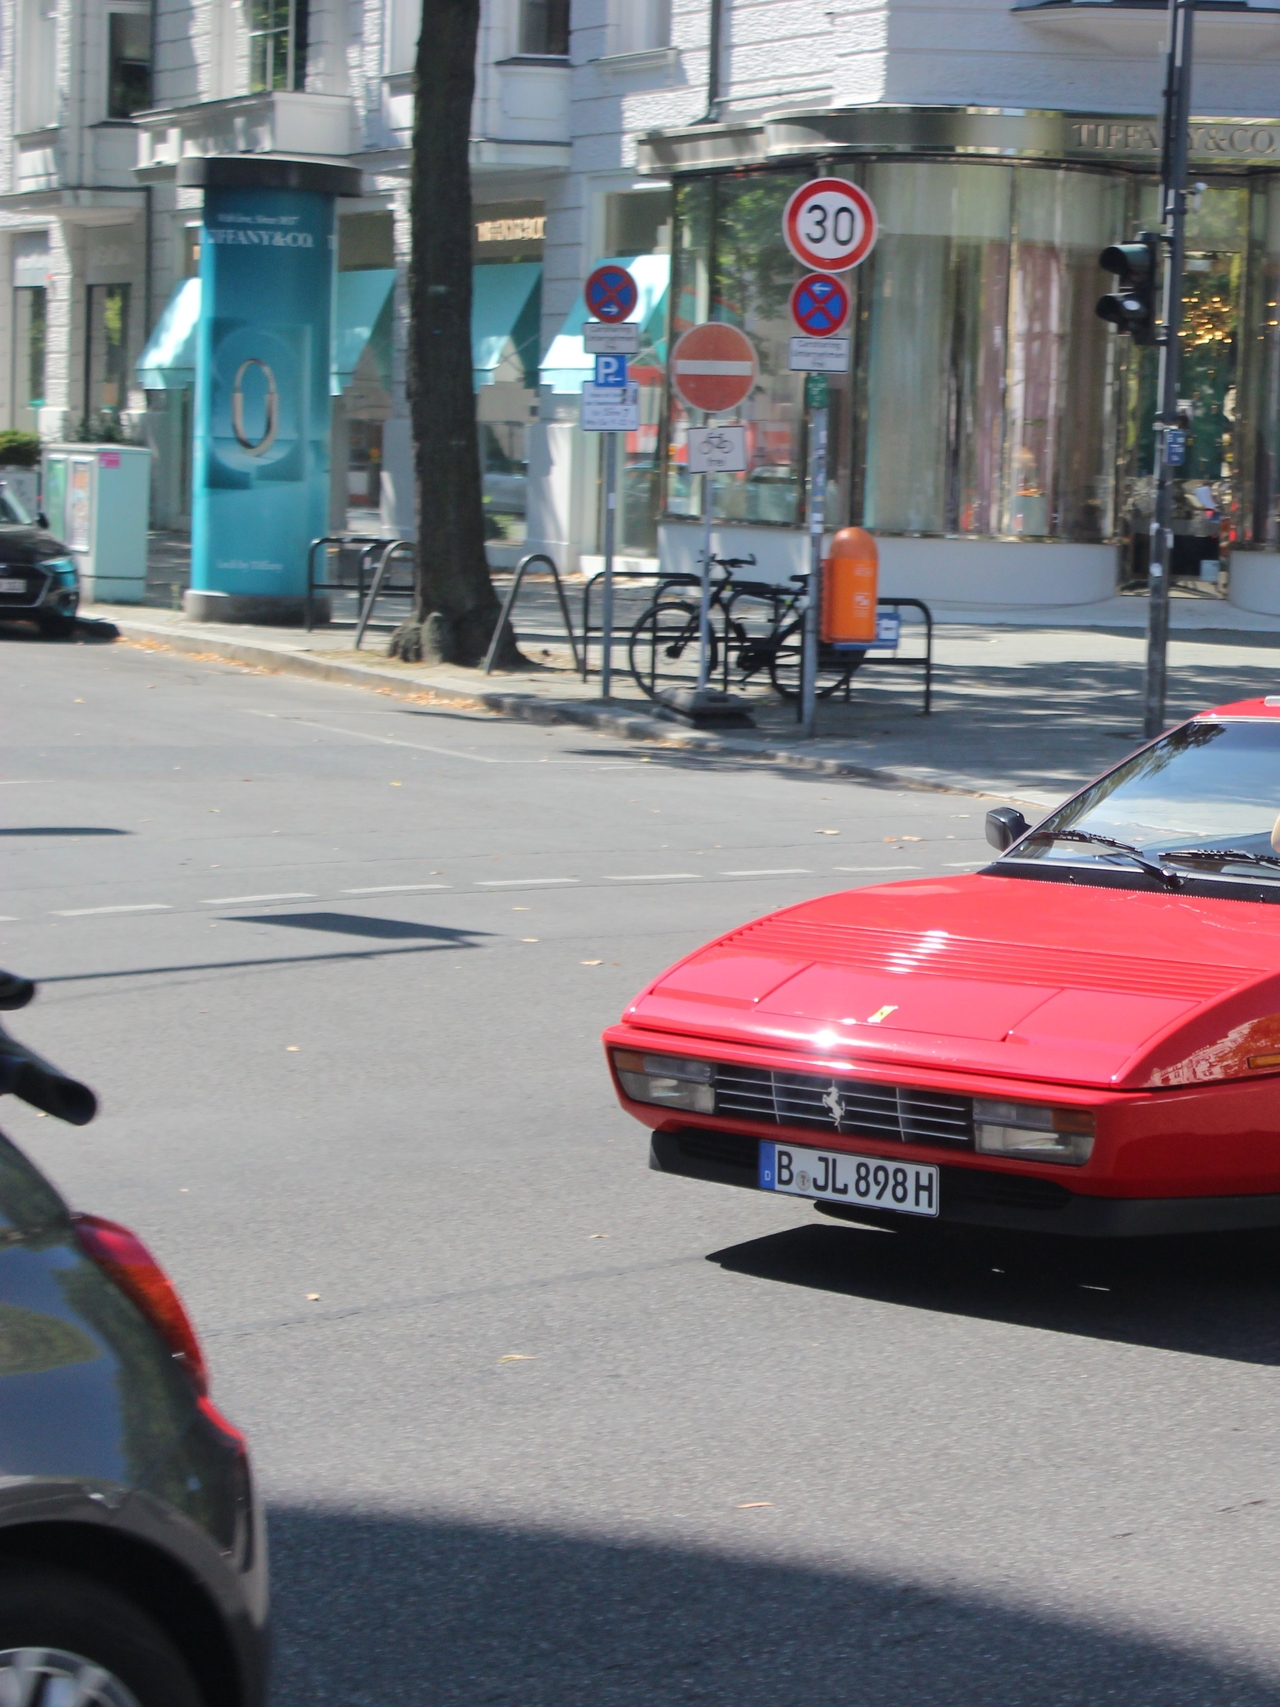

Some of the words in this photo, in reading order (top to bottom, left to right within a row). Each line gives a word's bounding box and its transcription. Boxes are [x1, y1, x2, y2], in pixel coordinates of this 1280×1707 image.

[1071, 122, 1277, 155] TIFFAY&CO.
[805, 204, 855, 247] 30
[597, 357, 619, 384] P
[777, 1150, 794, 1186] B
[812, 1156, 849, 1195] JL
